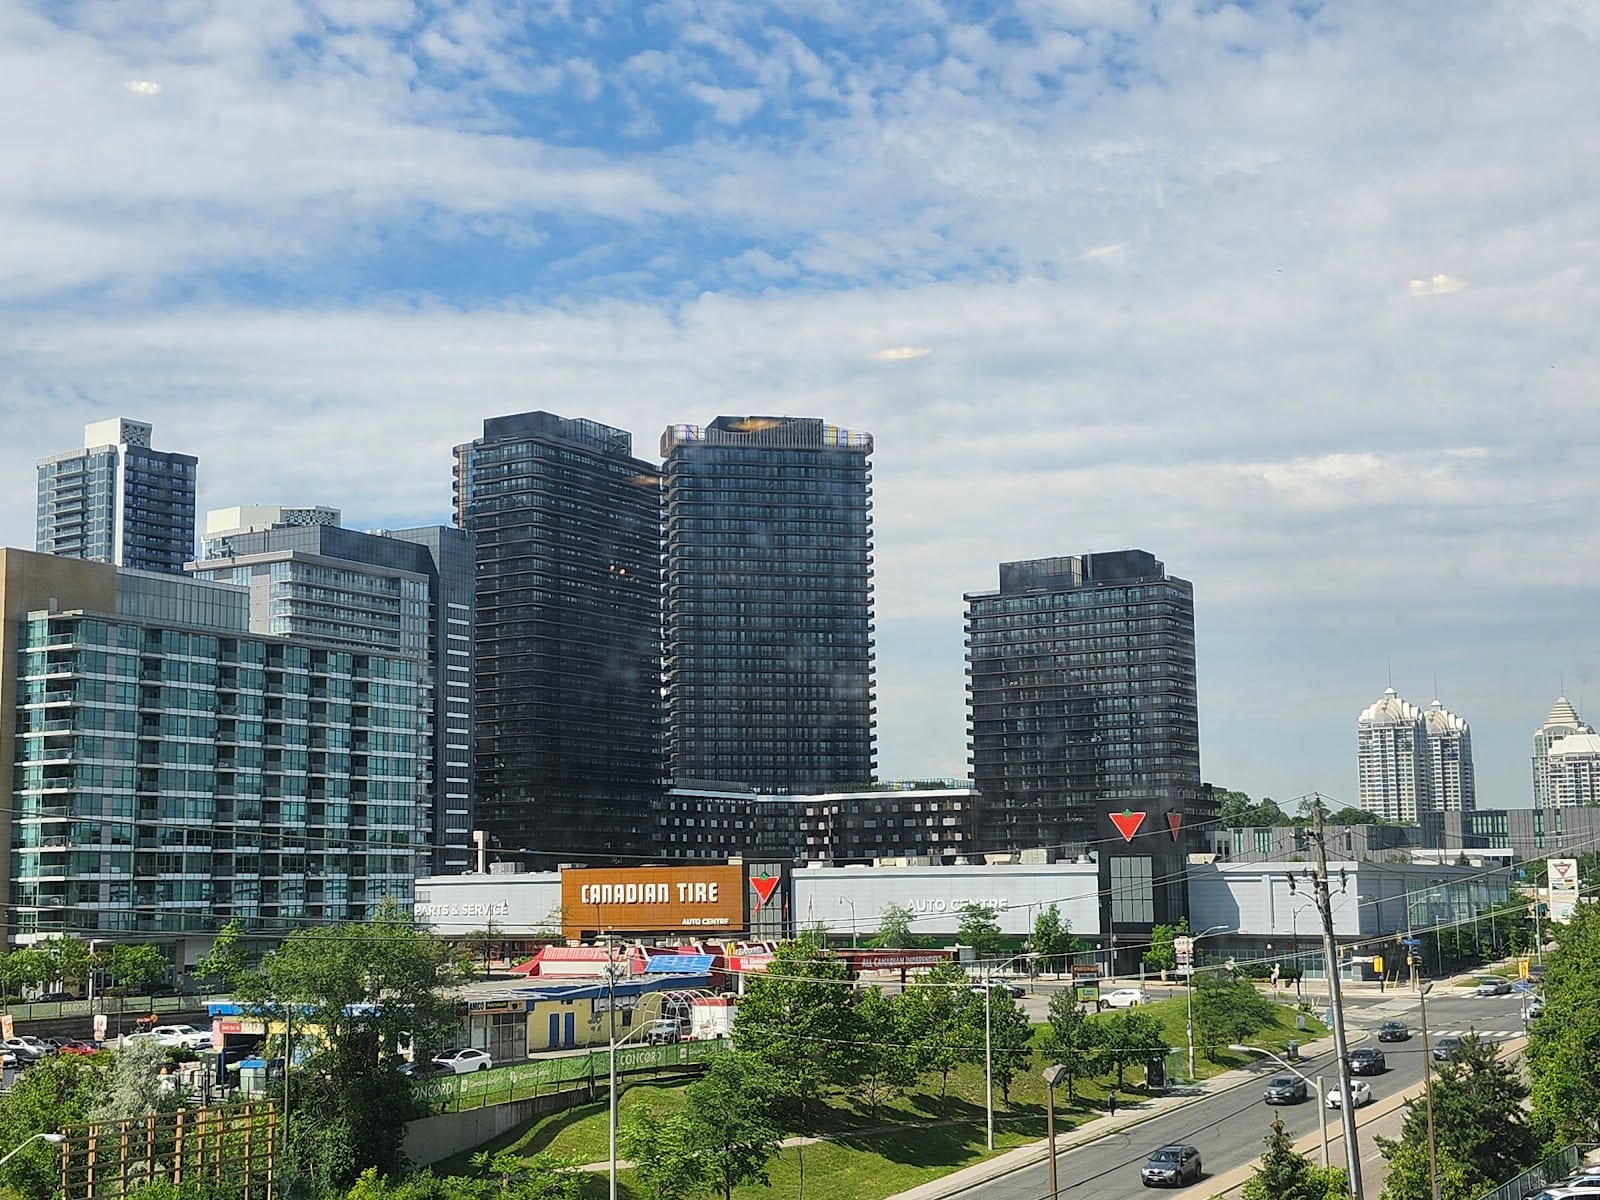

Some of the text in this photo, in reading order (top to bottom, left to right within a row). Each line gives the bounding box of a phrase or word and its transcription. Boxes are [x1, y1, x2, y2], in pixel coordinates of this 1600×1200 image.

[581, 882, 719, 904] CANADIAN TIRE
[414, 903, 509, 917] PARTS & SERVICE
[907, 898, 947, 912] AUTO
[681, 917, 729, 926] AUTO CENTRE
[620, 1050, 662, 1066] CONCORD
[410, 1082, 453, 1100] ONCORD
